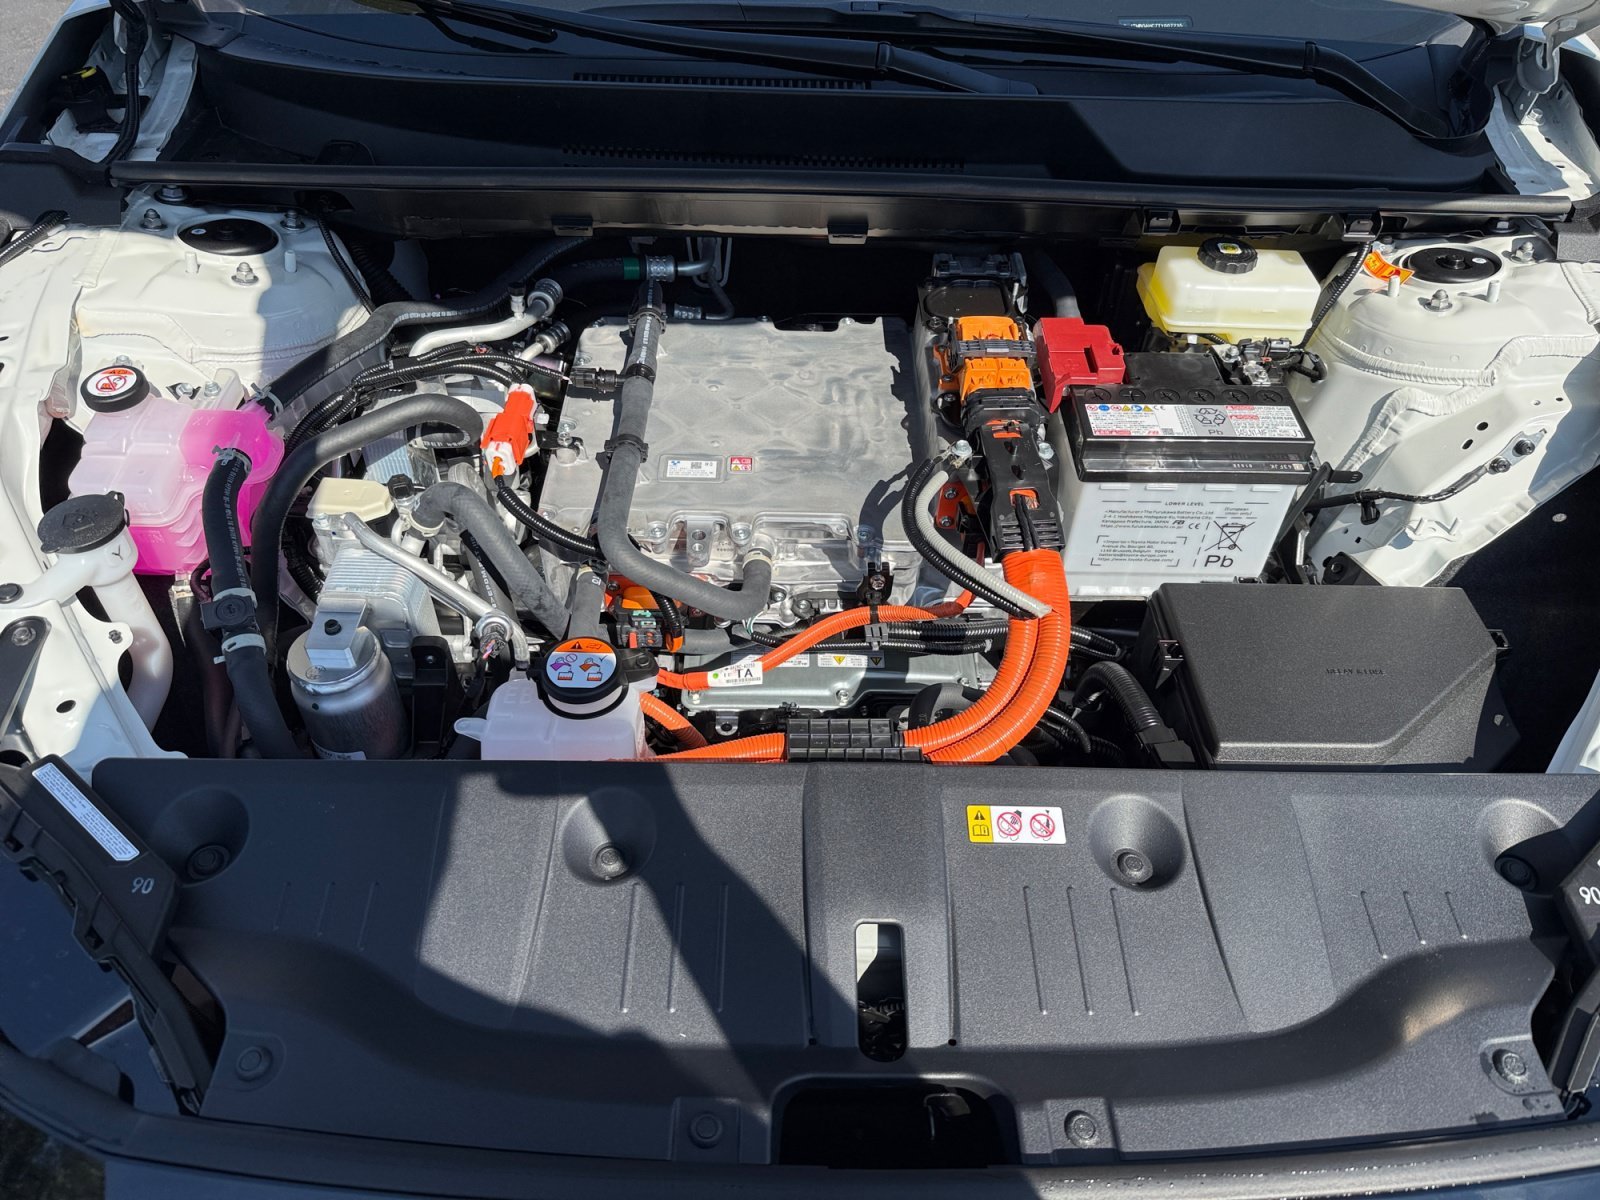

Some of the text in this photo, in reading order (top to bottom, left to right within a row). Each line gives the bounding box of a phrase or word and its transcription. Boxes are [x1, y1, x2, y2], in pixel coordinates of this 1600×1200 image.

[1204, 554, 1234, 568] Pb
[131, 877, 155, 893] 90
[1579, 886, 1600, 905] 90
